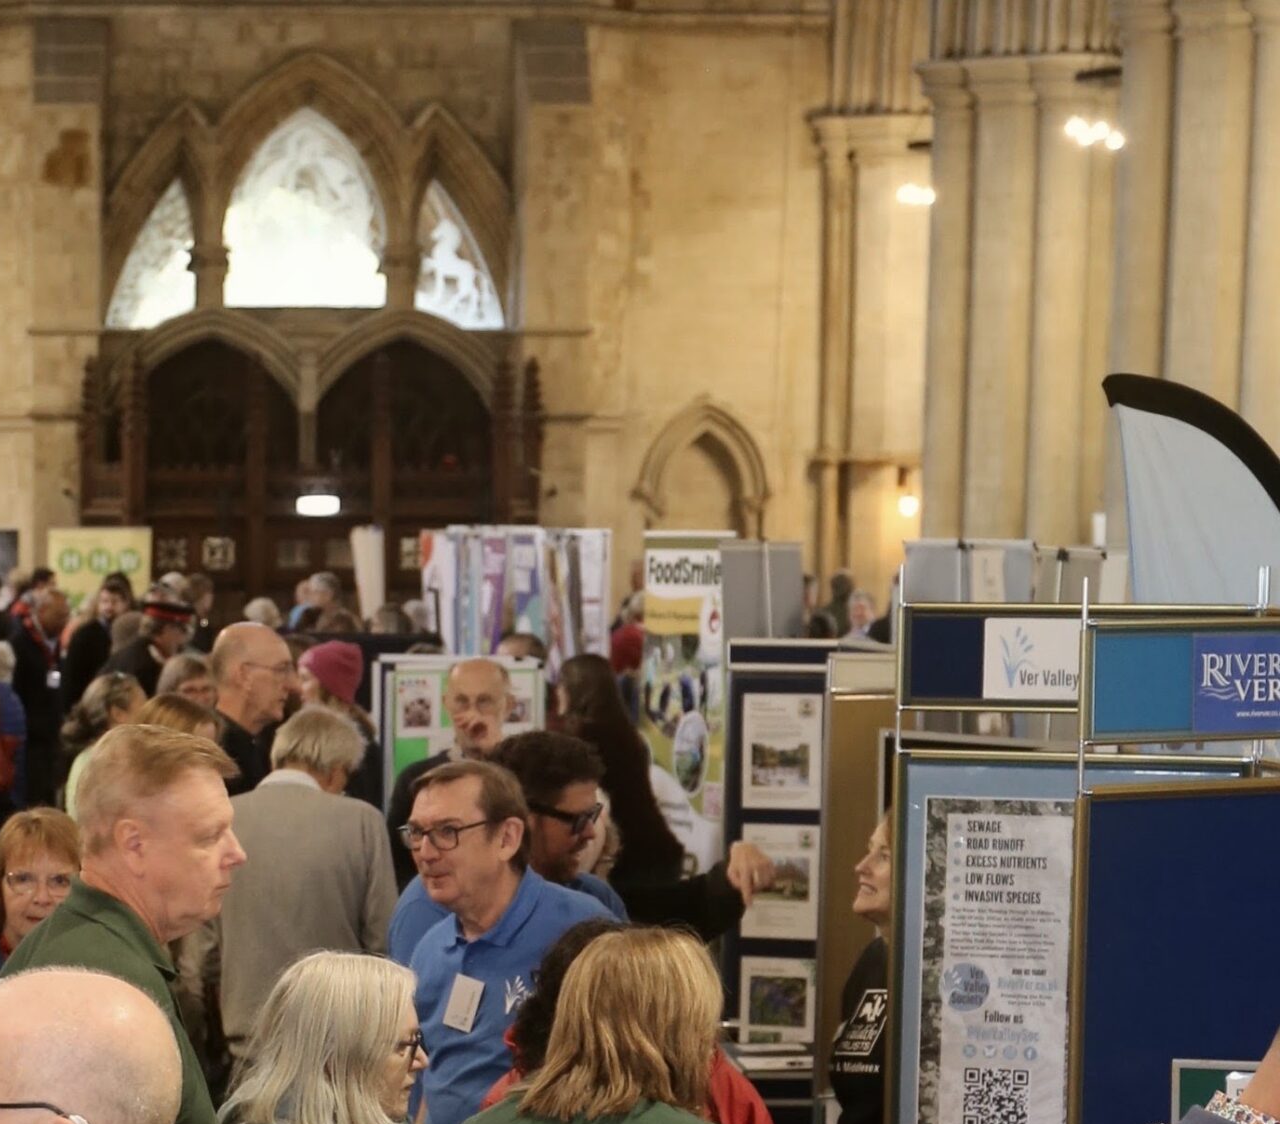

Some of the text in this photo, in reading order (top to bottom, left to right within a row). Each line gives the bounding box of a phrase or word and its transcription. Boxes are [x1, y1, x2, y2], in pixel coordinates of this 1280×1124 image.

[1201, 652, 1280, 687] RIVER
[1019, 669, 1080, 692] Ver Valley
[1234, 678, 1280, 702] VER
[967, 820, 1002, 833] SEWAGE
[966, 838, 1025, 851] ROAD RUNOFF
[966, 855, 1048, 870] EXCESS NUTRIENTS
[965, 873, 1015, 886] LOW FLOWS
[964, 890, 1041, 905] INVASIVE SPECIES
[969, 966, 984, 979] Ver
[963, 980, 990, 994] Valley
[984, 1010, 1024, 1025] Follow us
